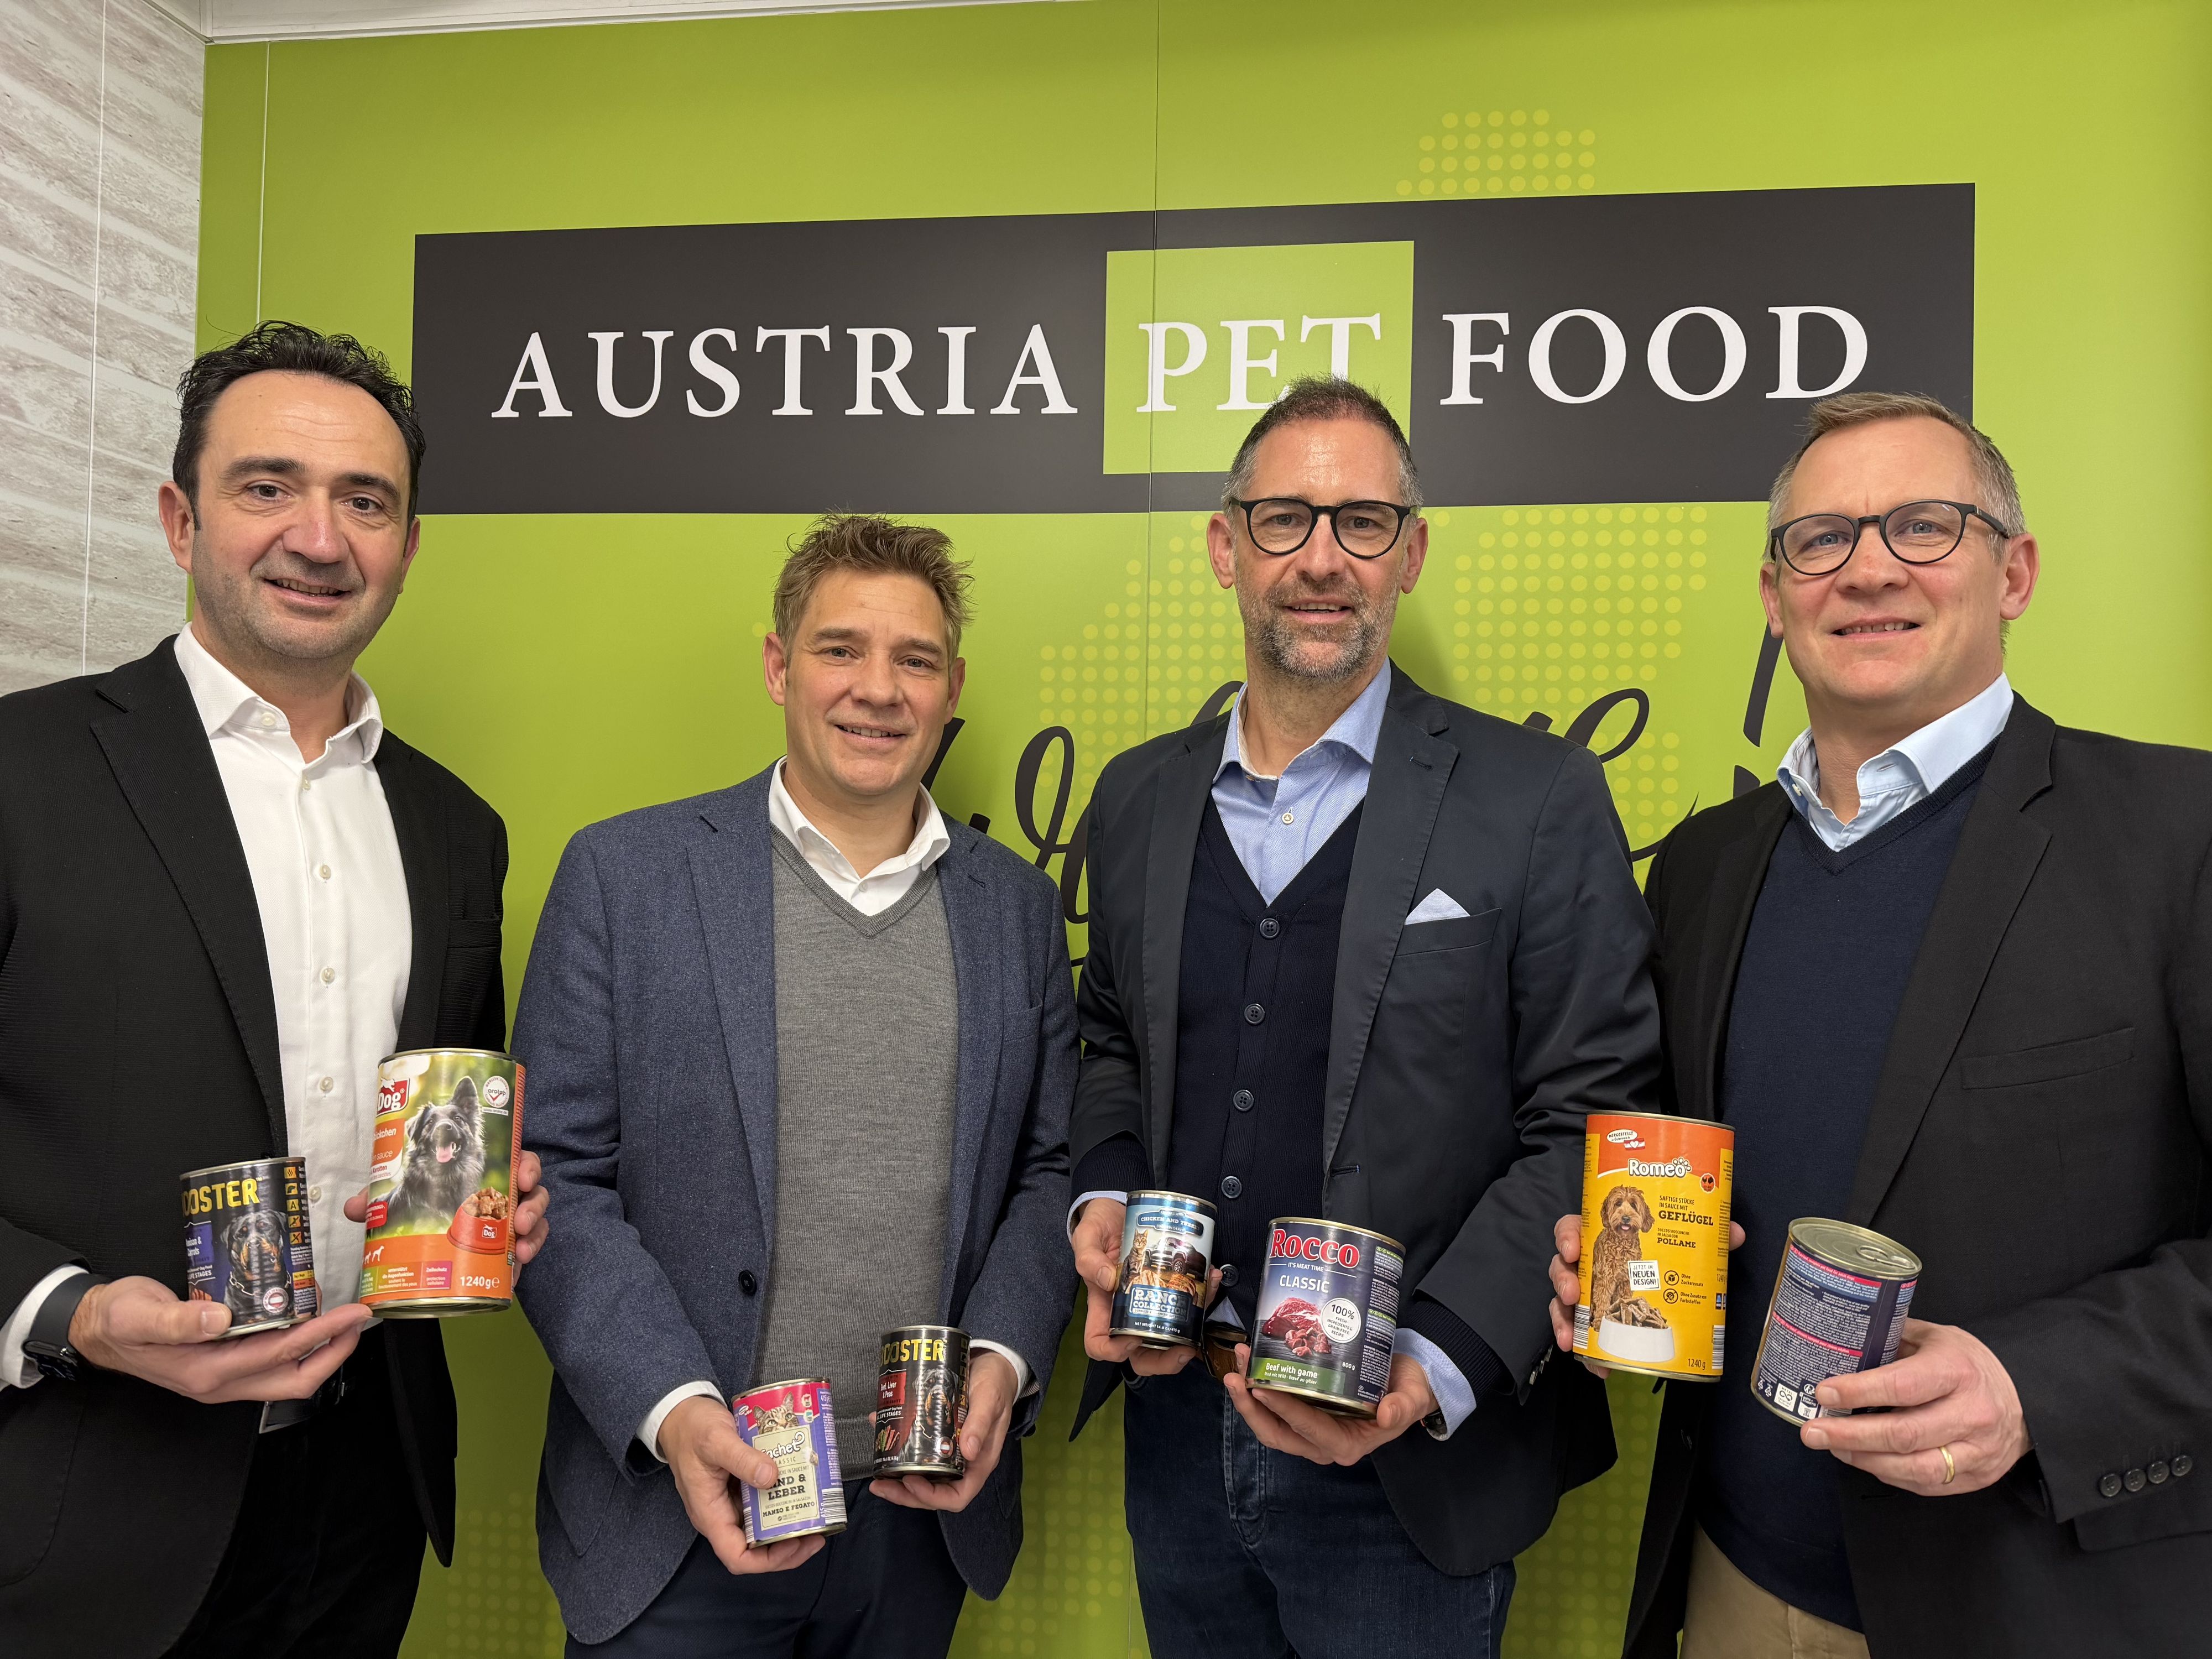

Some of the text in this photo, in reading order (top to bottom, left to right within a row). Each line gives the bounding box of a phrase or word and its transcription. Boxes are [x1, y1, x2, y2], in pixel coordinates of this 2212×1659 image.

[492, 306, 1867, 418] AUSTRIA PET FOOD
[378, 1092, 401, 1111] Dog
[1629, 1159, 1686, 1177] Romeo
[1658, 1210, 1714, 1225] GEFLÜGEL
[197, 1236, 202, 1244] &
[483, 1229, 495, 1238] Dog
[1657, 1238, 1695, 1248] POLLAME
[195, 1270, 212, 1278] STAGES
[1280, 1275, 1330, 1293] CLASSIC
[1134, 1289, 1187, 1307] RANCH
[1133, 1301, 1186, 1316] COLLECTION
[1332, 1305, 1354, 1320] 100%
[1327, 1319, 1349, 1330] INGREDIENTS
[1328, 1324, 1350, 1334] GRAIN-FREE
[1266, 1363, 1318, 1379] Beef with game
[1688, 1358, 1705, 1370] 1240 g
[761, 1431, 805, 1459] achet
[799, 1474, 806, 1483] &
[768, 1485, 806, 1501] LEBER
[763, 1507, 784, 1517] MANZO
[791, 1501, 815, 1510] FEGATO
